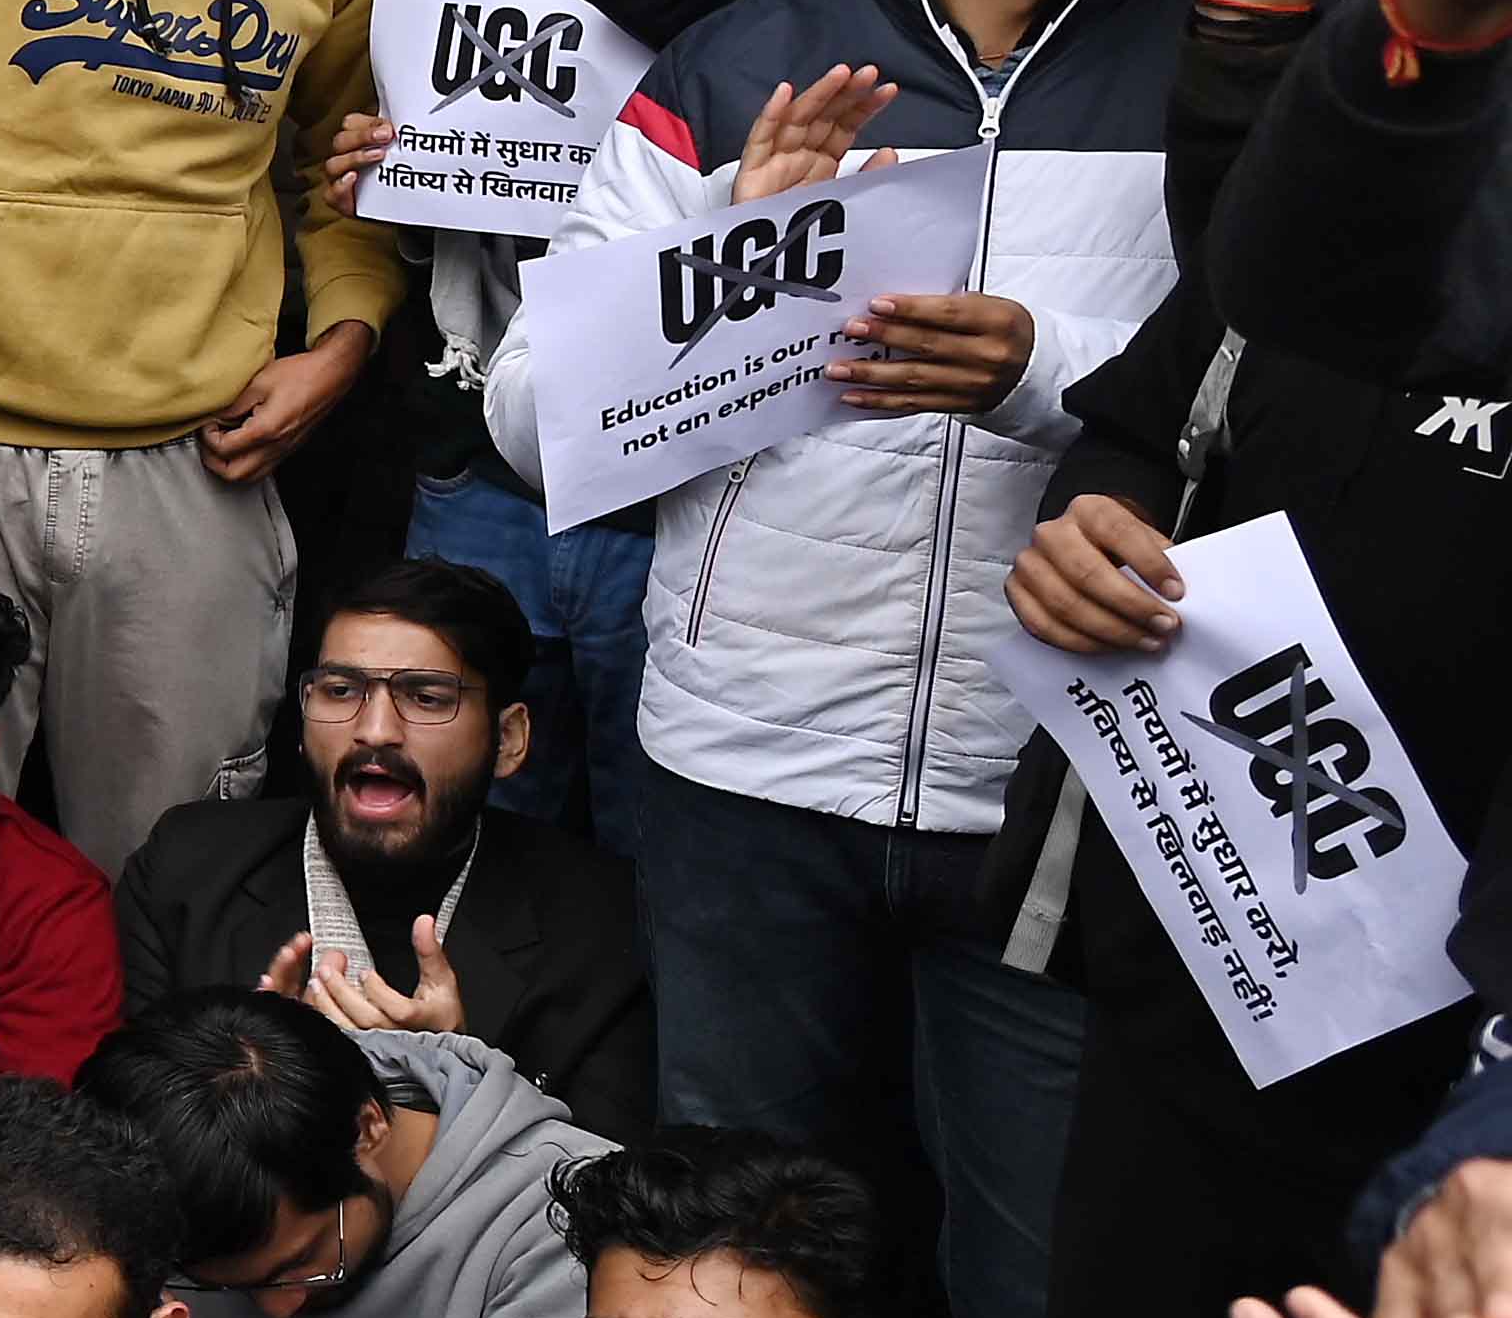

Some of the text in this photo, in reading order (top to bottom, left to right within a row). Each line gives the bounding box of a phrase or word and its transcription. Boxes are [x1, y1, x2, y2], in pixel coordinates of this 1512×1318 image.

[112, 74, 154, 99] TOKYO
[152, 86, 194, 112] JAPAN
[431, 3, 583, 105] UGC
[399, 124, 464, 156] नियमों
[470, 131, 491, 158] में
[496, 140, 562, 168] सुधार
[658, 199, 845, 344] UGC
[600, 368, 736, 432] Education
[744, 354, 764, 377] is
[771, 334, 820, 365] our
[1209, 643, 1406, 881] UGC
[1122, 677, 1300, 978] नियमों में सुधार करो,
